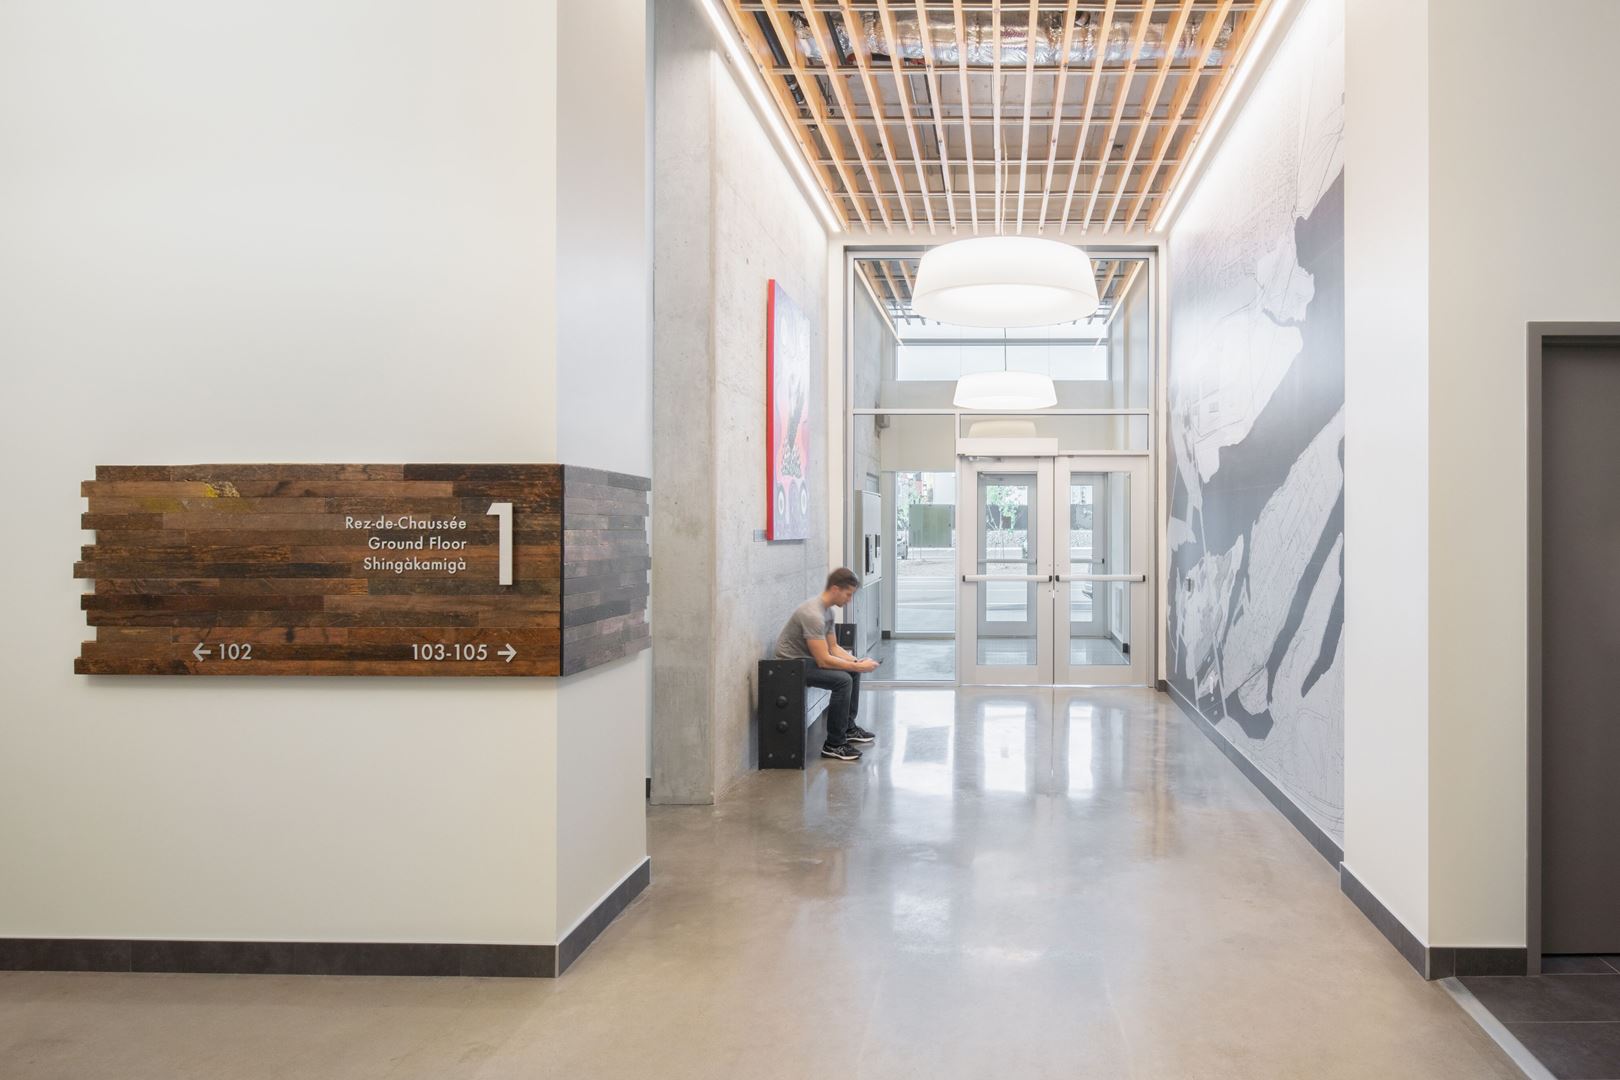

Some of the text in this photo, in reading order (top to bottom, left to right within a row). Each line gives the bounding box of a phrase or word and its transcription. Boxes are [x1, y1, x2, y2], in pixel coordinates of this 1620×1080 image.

[345, 516, 467, 530] Rez-de-Chaussée
[368, 536, 467, 550] Ground Floor
[486, 502, 513, 585] 1
[363, 556, 466, 574] Shingàkamigà
[219, 643, 252, 660] 102
[411, 644, 487, 661] 103-105
